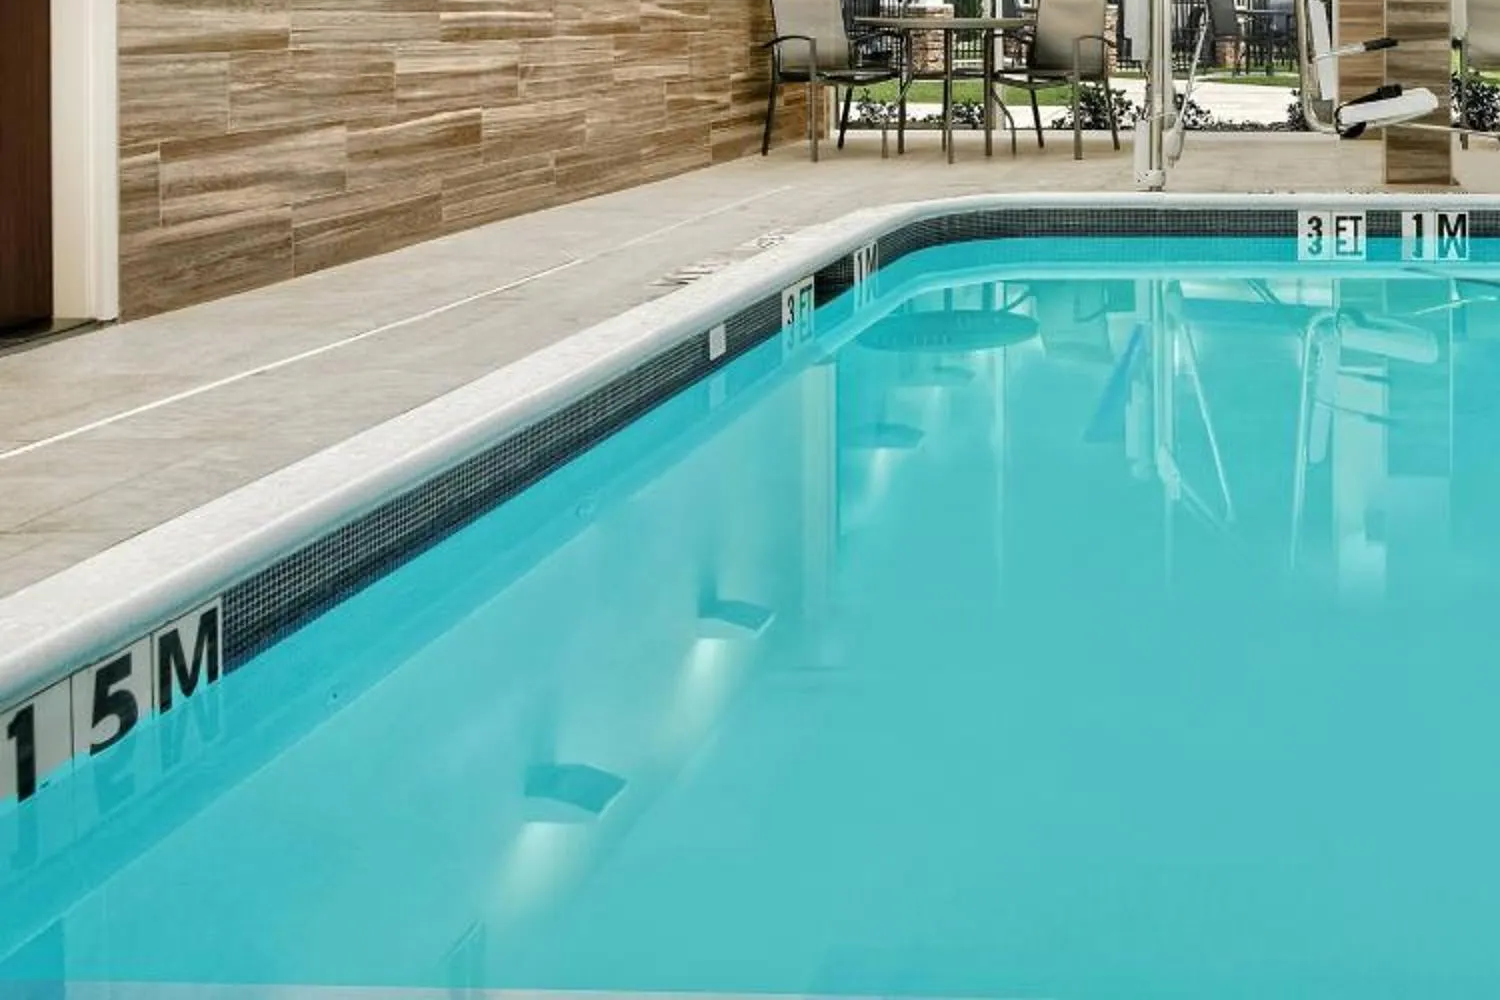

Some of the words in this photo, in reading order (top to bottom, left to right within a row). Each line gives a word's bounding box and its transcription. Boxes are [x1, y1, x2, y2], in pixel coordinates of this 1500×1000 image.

[1307, 215, 1323, 238] 3
[1335, 215, 1363, 238] FT
[1412, 213, 1424, 238] 1
[1438, 213, 1467, 239] M
[158, 606, 219, 716] M
